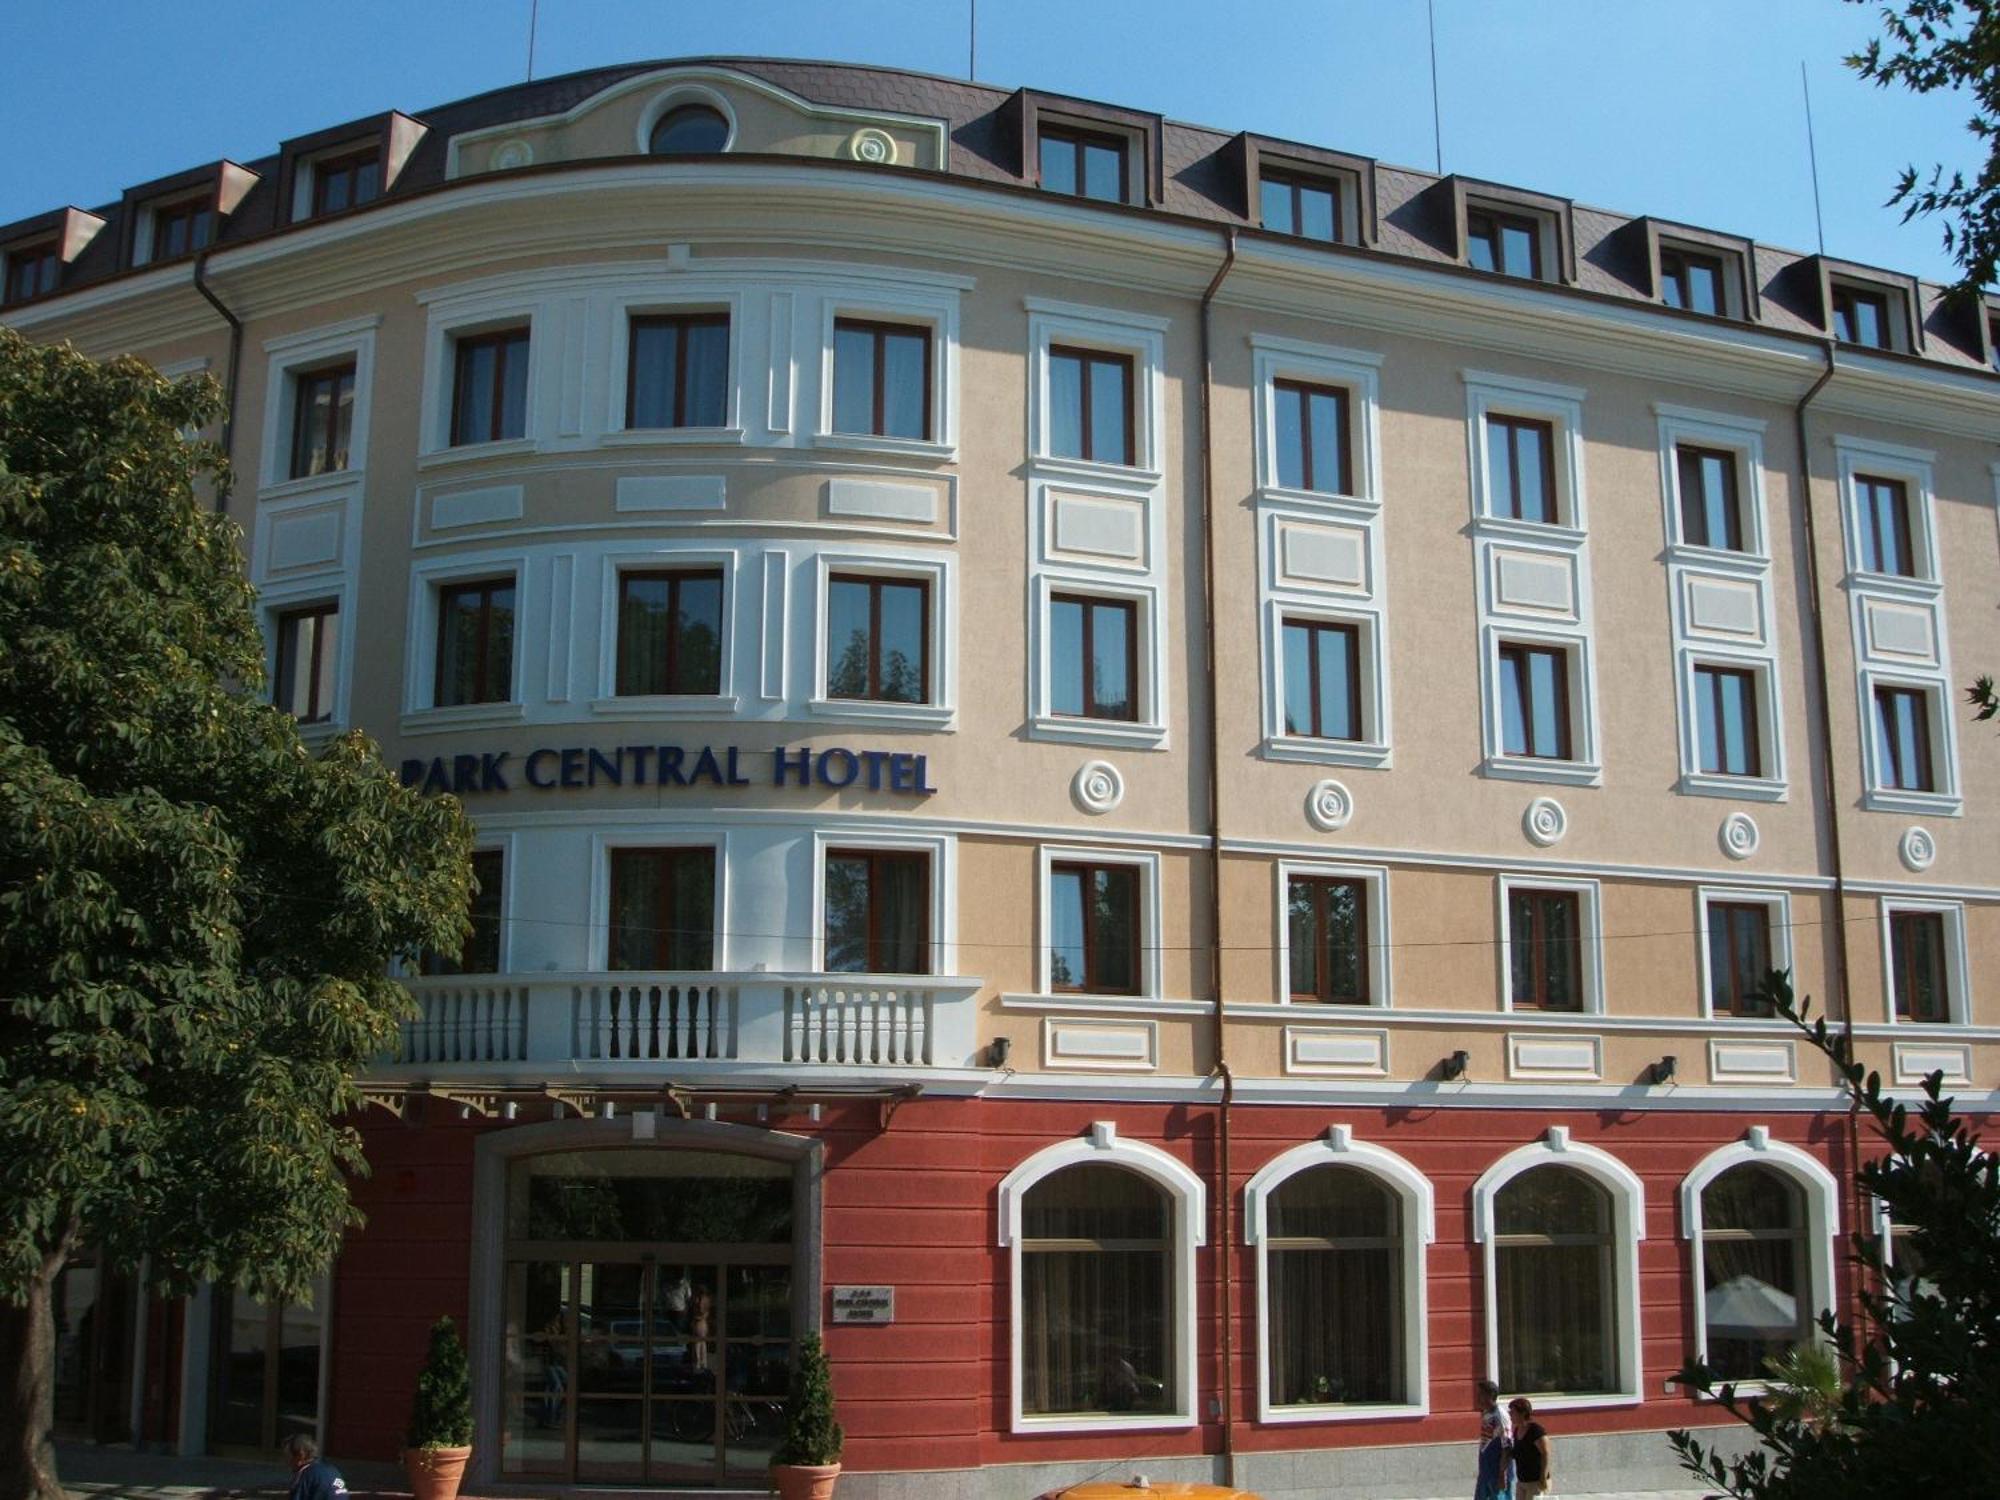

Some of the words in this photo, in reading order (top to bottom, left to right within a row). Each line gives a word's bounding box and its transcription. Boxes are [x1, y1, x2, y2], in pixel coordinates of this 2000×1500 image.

[401, 751, 512, 796] PARK
[525, 745, 751, 789] CENTRAL
[773, 745, 938, 796] HOTEL
